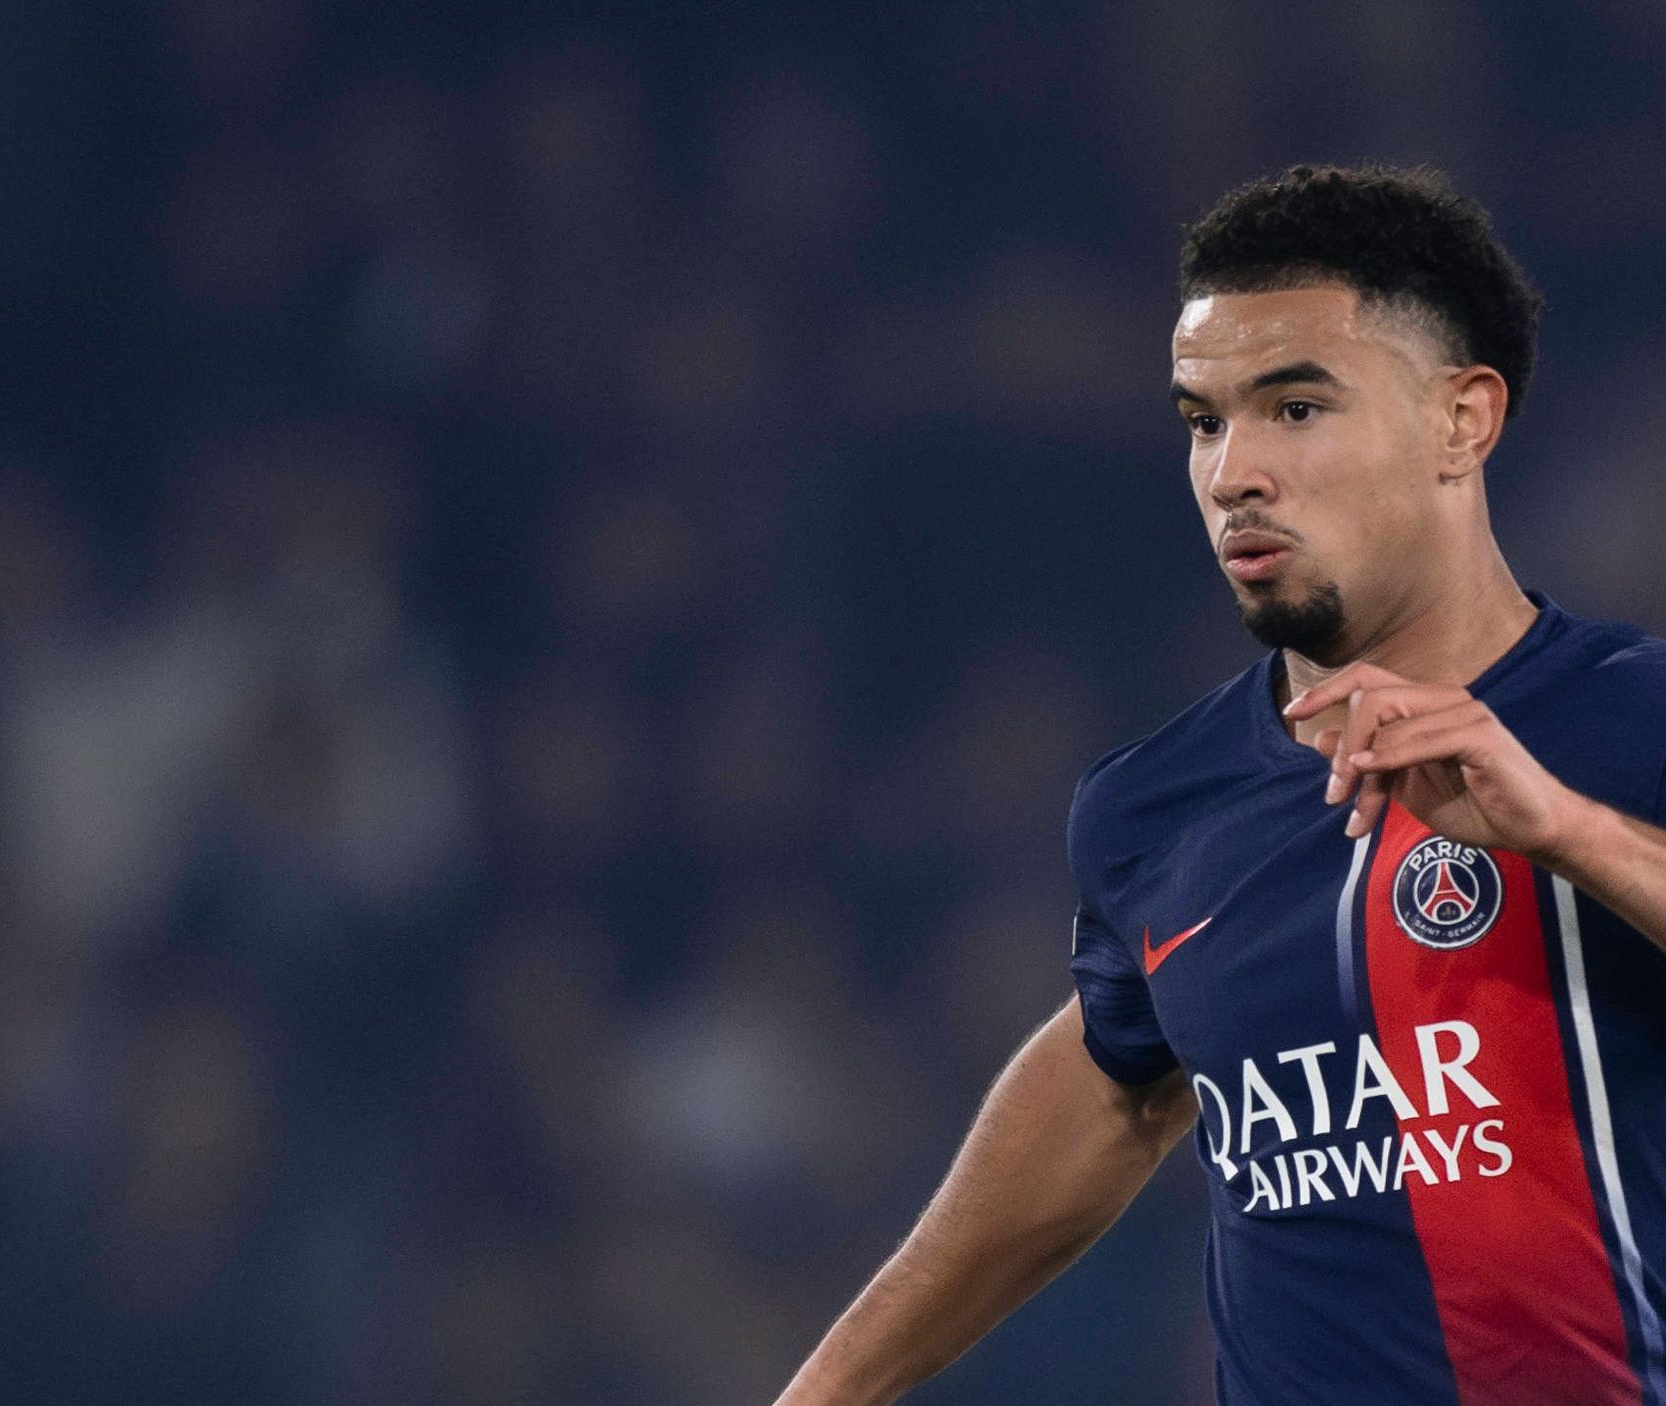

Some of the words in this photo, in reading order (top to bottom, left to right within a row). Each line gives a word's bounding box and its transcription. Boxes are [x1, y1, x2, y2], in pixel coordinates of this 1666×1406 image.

[1408, 841, 1478, 872] PARIS
[1192, 1019, 1501, 1182] QATAR
[1243, 1119, 1513, 1213] AIRWAYS
